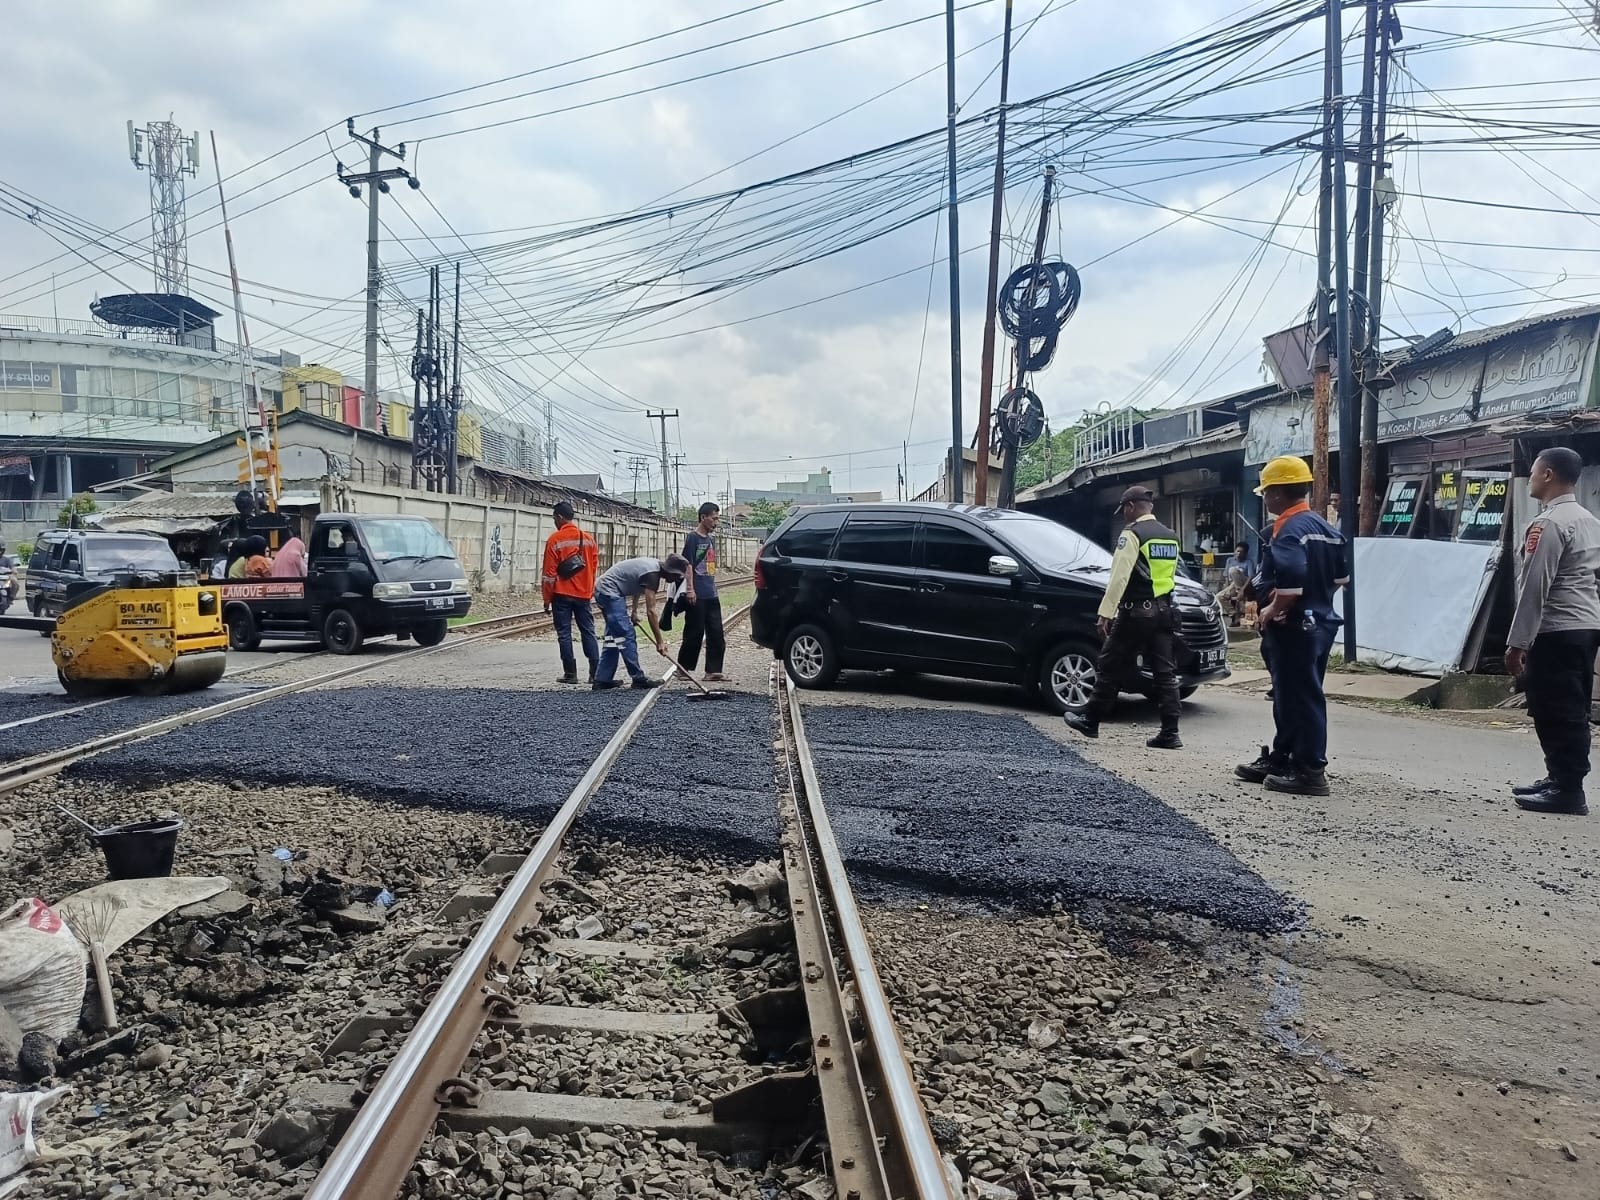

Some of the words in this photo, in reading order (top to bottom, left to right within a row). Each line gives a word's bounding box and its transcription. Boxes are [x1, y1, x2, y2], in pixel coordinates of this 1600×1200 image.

[16, 373, 50, 382] STUDIO
[1387, 420, 1412, 435] Kocok
[1449, 410, 1477, 426] Campr
[1478, 406, 1484, 418] &
[1485, 402, 1509, 416] Aneka
[1547, 388, 1577, 405] Dingin
[1439, 487, 1457, 498] AYAM
[1476, 512, 1504, 525] KOCOK
[1150, 544, 1177, 557] SATPAM
[221, 586, 263, 598] LAMOVE
